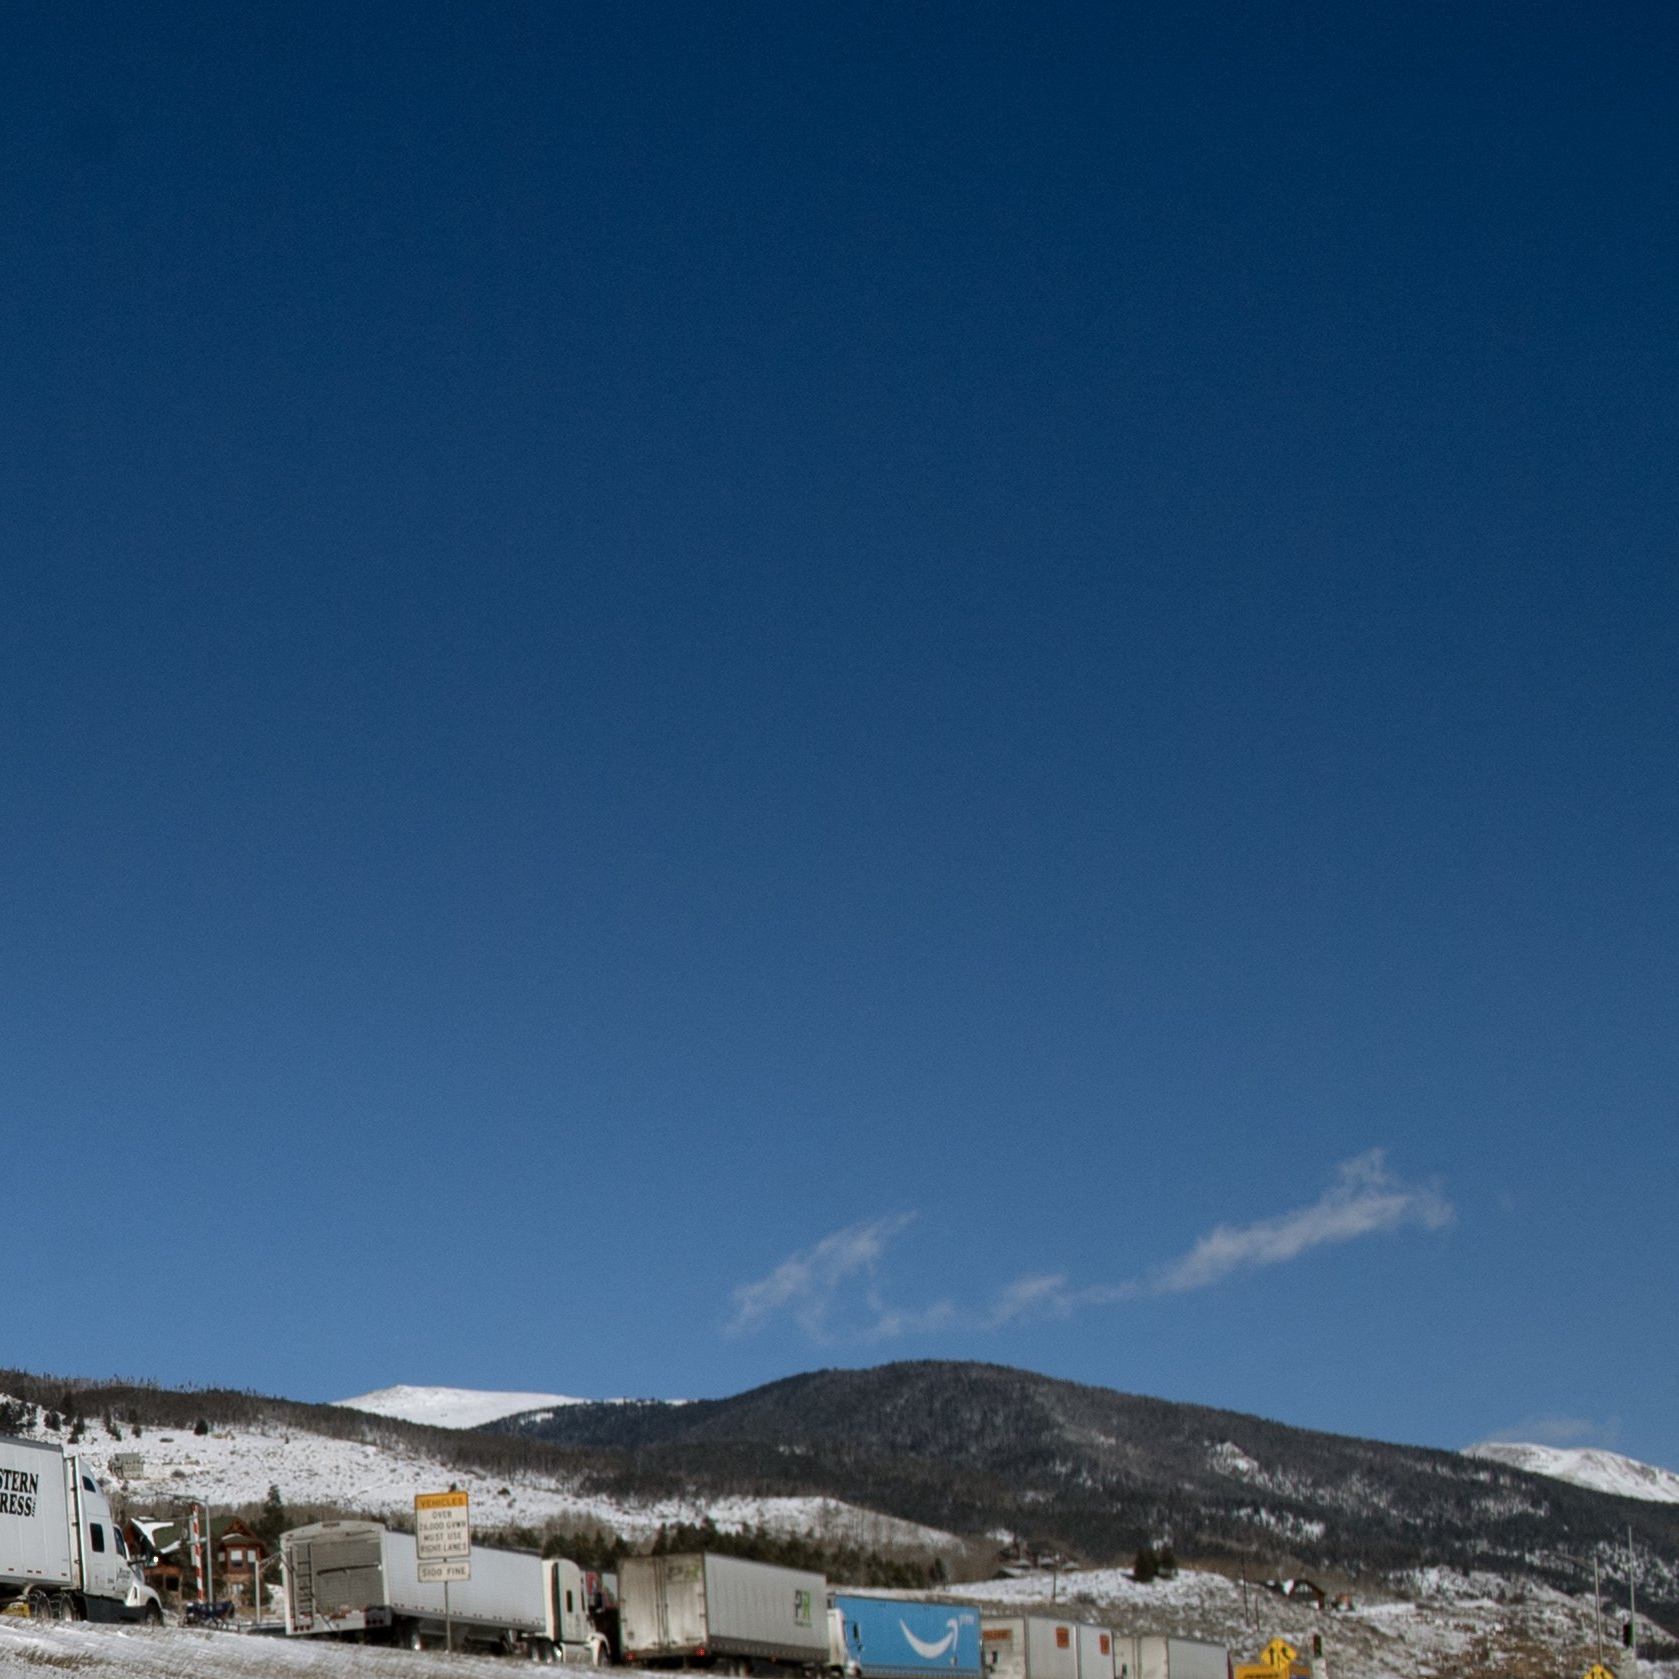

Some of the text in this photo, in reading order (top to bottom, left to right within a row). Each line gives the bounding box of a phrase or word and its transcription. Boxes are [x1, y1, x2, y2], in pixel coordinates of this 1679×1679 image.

[421, 1498, 464, 1508] VEHICLES
[432, 1510, 452, 1519] OVER
[424, 1531, 462, 1542] MUST USE
[420, 1543, 466, 1552] RIGHT LANES
[422, 1566, 466, 1577] $100 FINE
